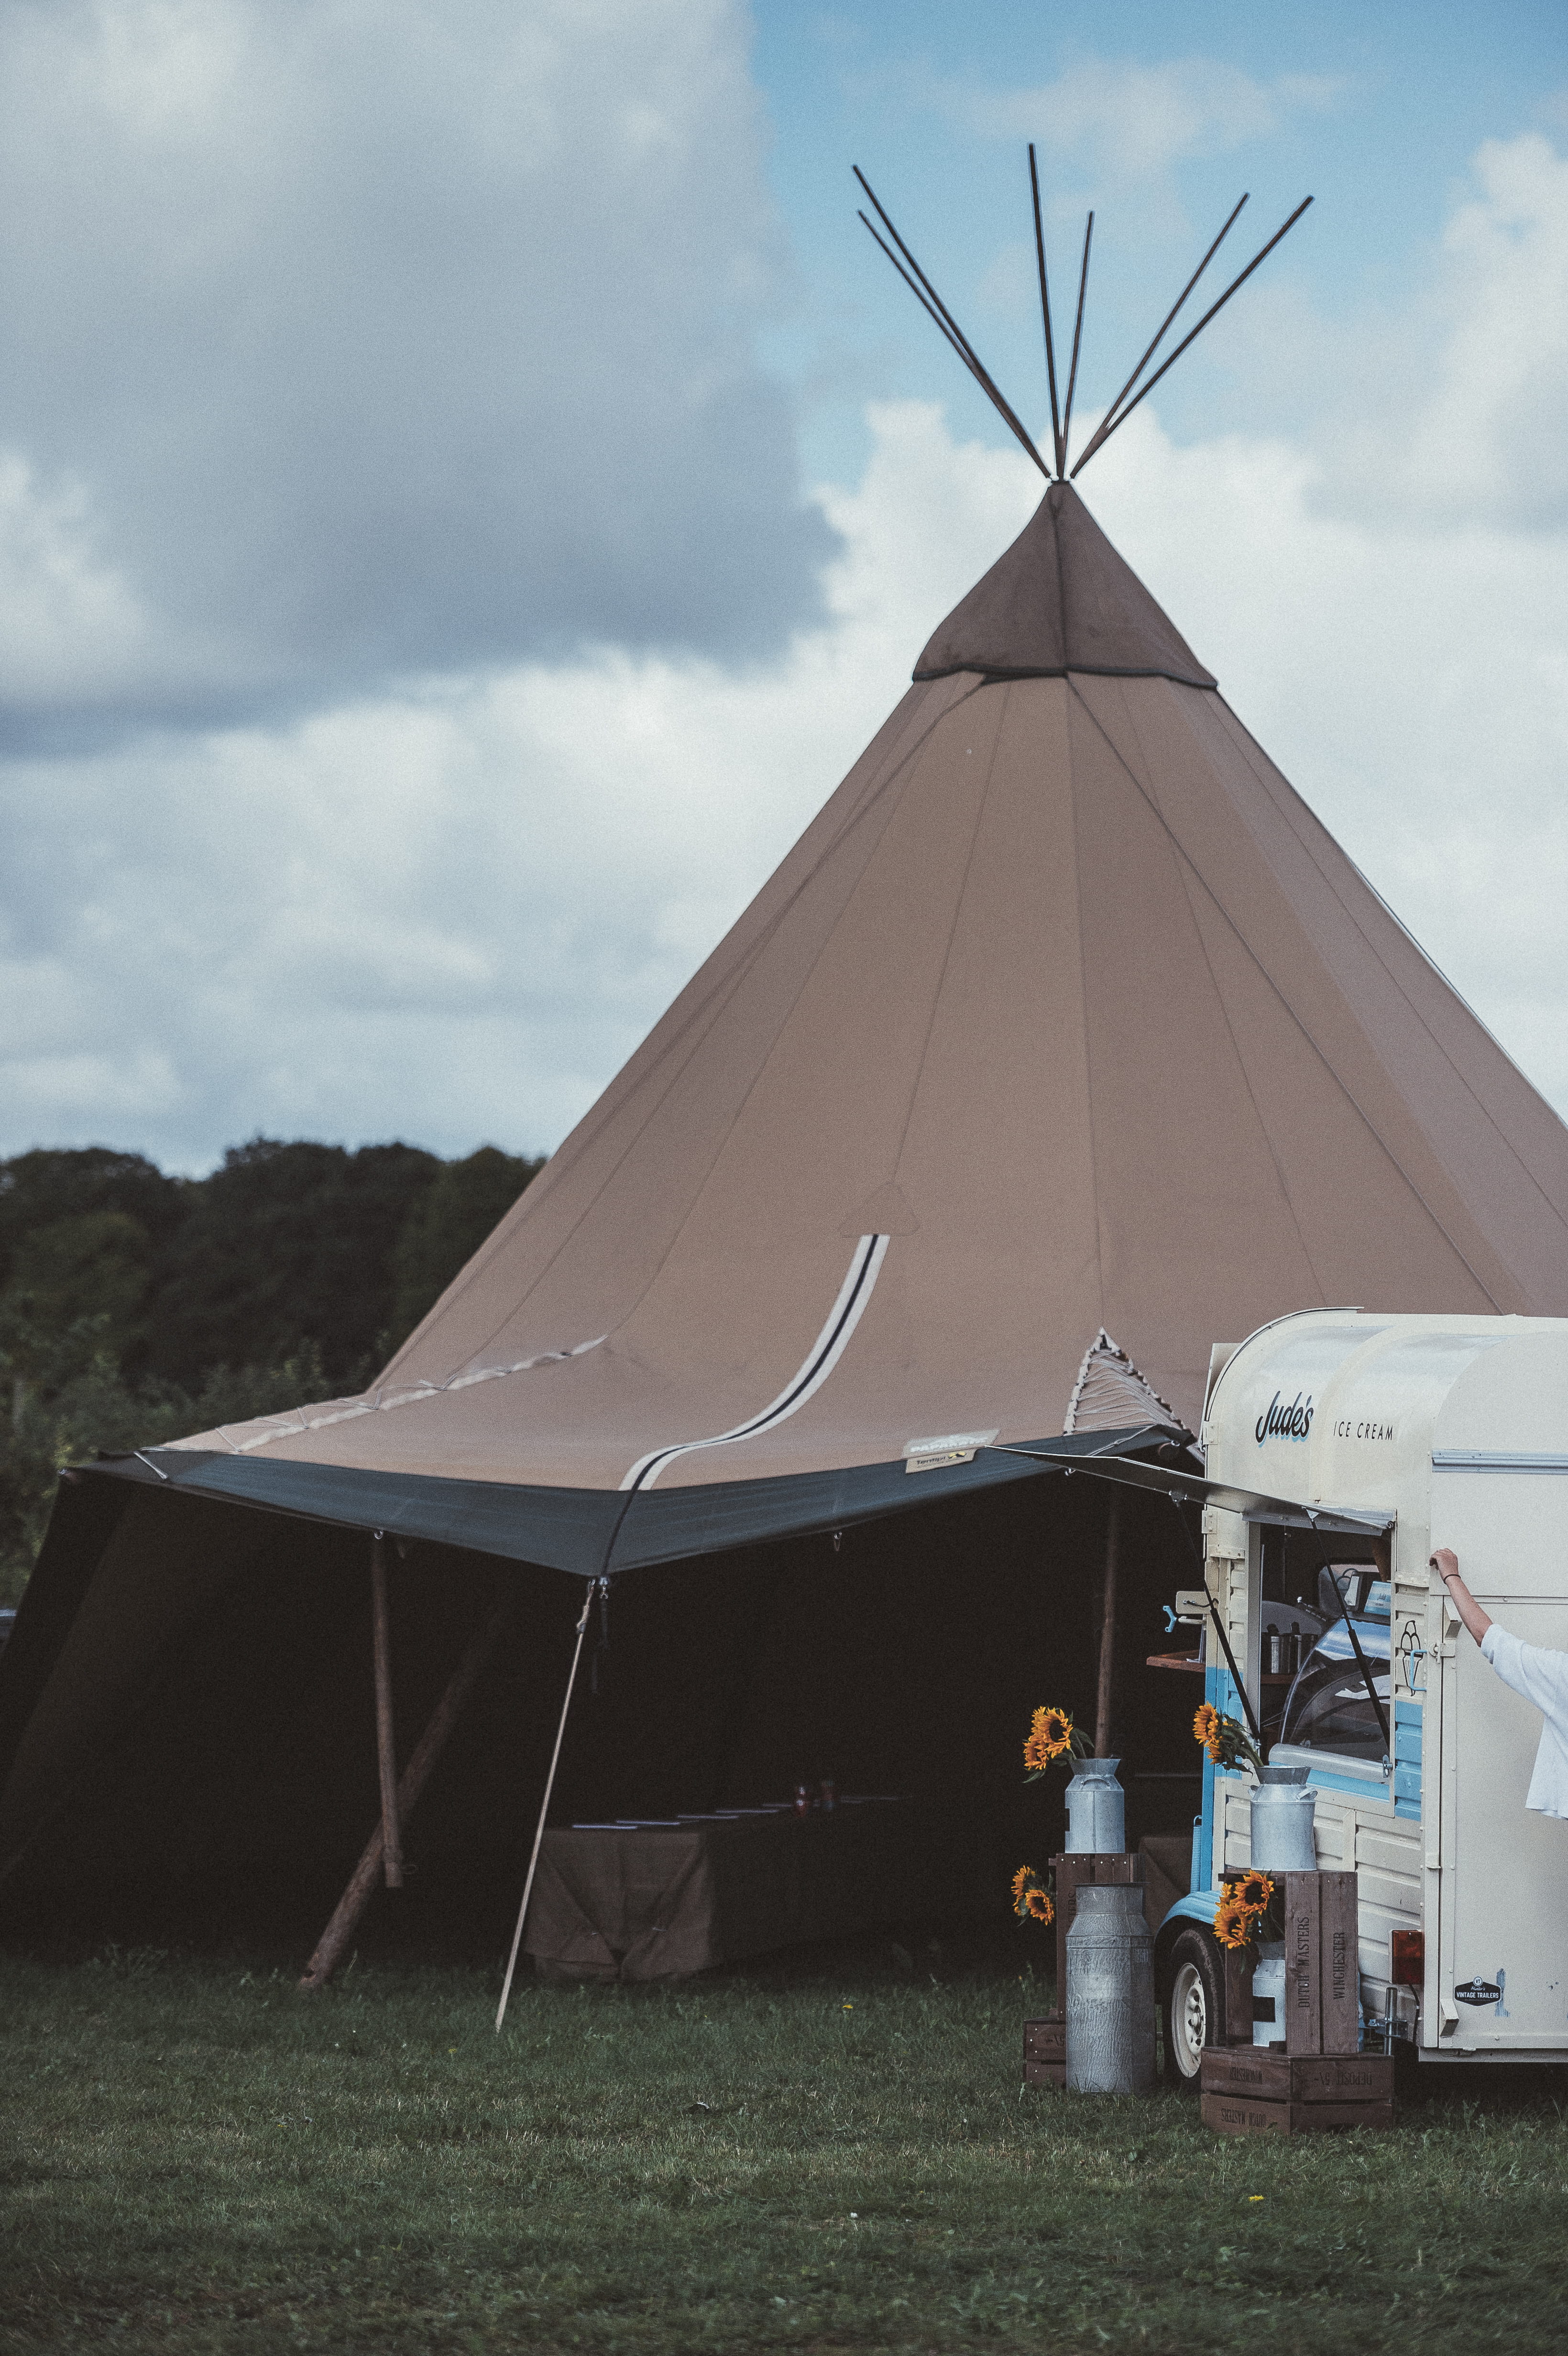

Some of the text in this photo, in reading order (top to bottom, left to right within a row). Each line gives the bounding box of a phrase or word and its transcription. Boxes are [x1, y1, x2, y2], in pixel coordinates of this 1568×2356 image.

[1256, 1391, 1314, 1446] Jude's
[1334, 1421, 1393, 1441] ICE CREAM
[1297, 1916, 1310, 2008] DUTCH MASTERS
[1333, 1932, 1346, 2000] WINCHESTER
[1229, 2066, 1262, 2084] WINCHESTER
[1221, 2108, 1266, 2128] DUTCH MASTERS
